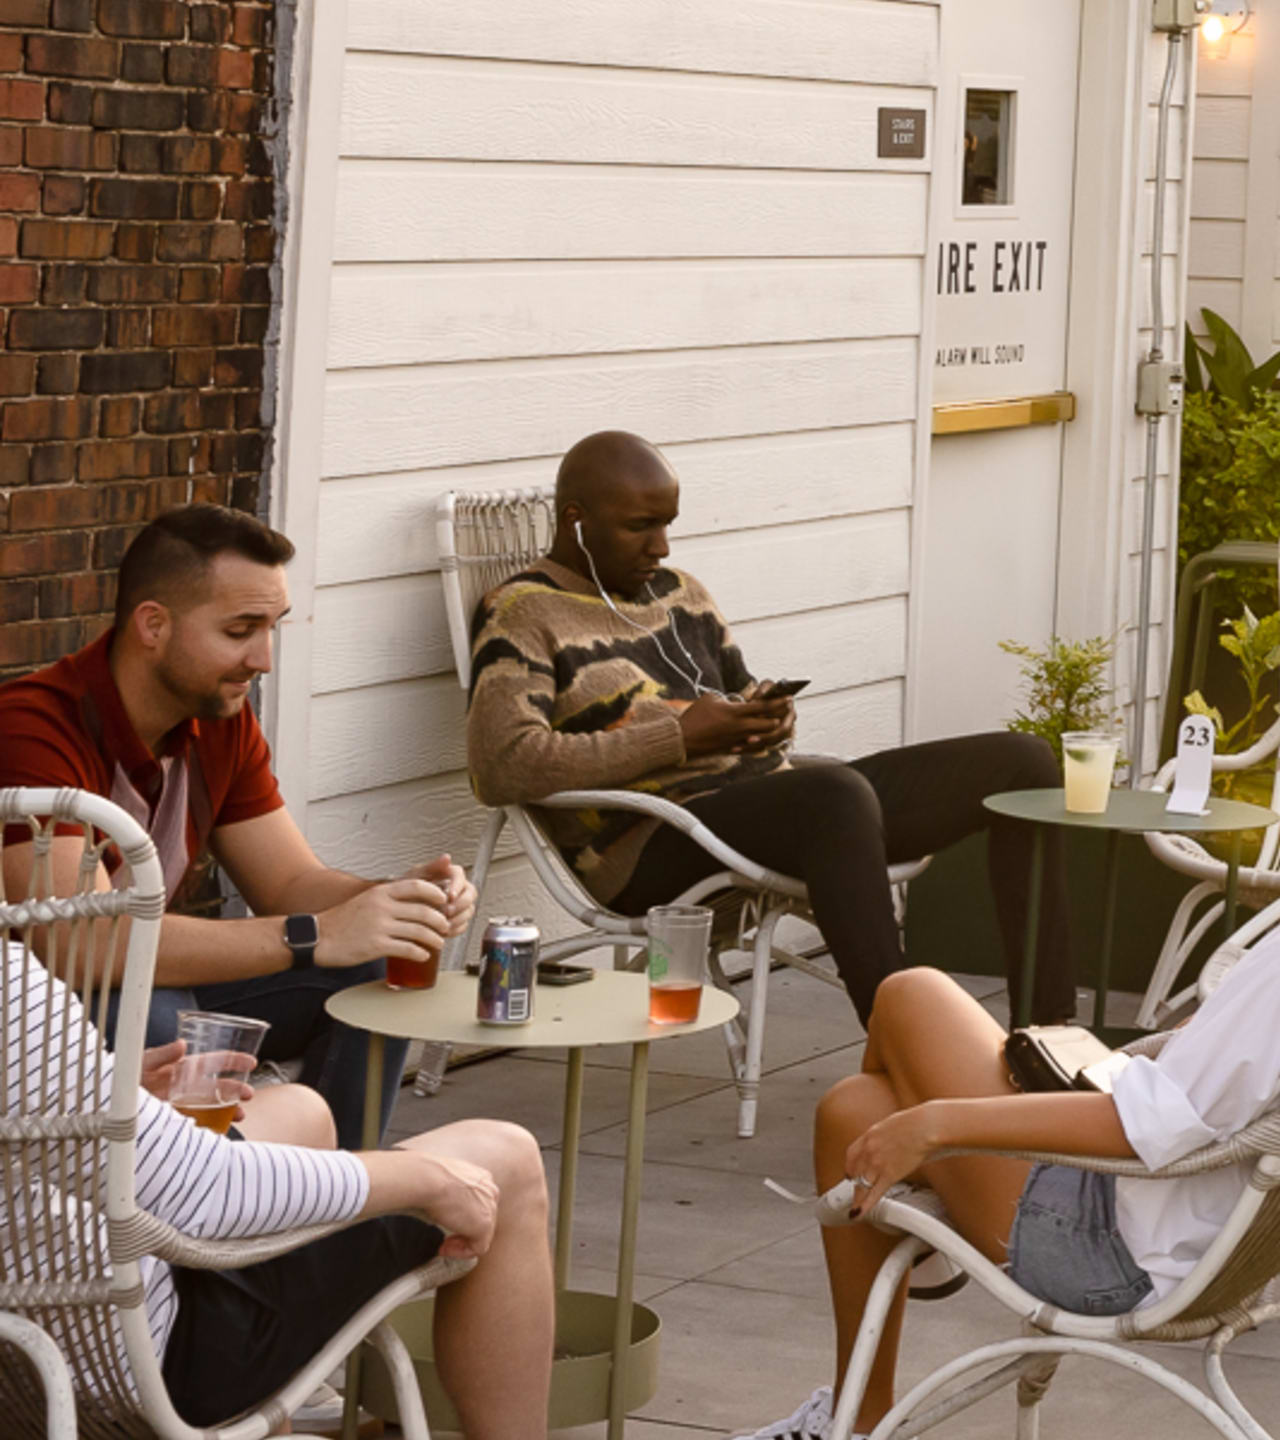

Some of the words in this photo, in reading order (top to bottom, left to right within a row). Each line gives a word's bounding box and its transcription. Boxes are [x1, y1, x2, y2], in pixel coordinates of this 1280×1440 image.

[937, 242, 977, 295] IRE
[992, 241, 1047, 293] EXIT
[935, 348, 967, 367] ALARM
[971, 346, 991, 365] WILL
[995, 344, 1024, 364] SOUND
[1184, 725, 1210, 746] 23
